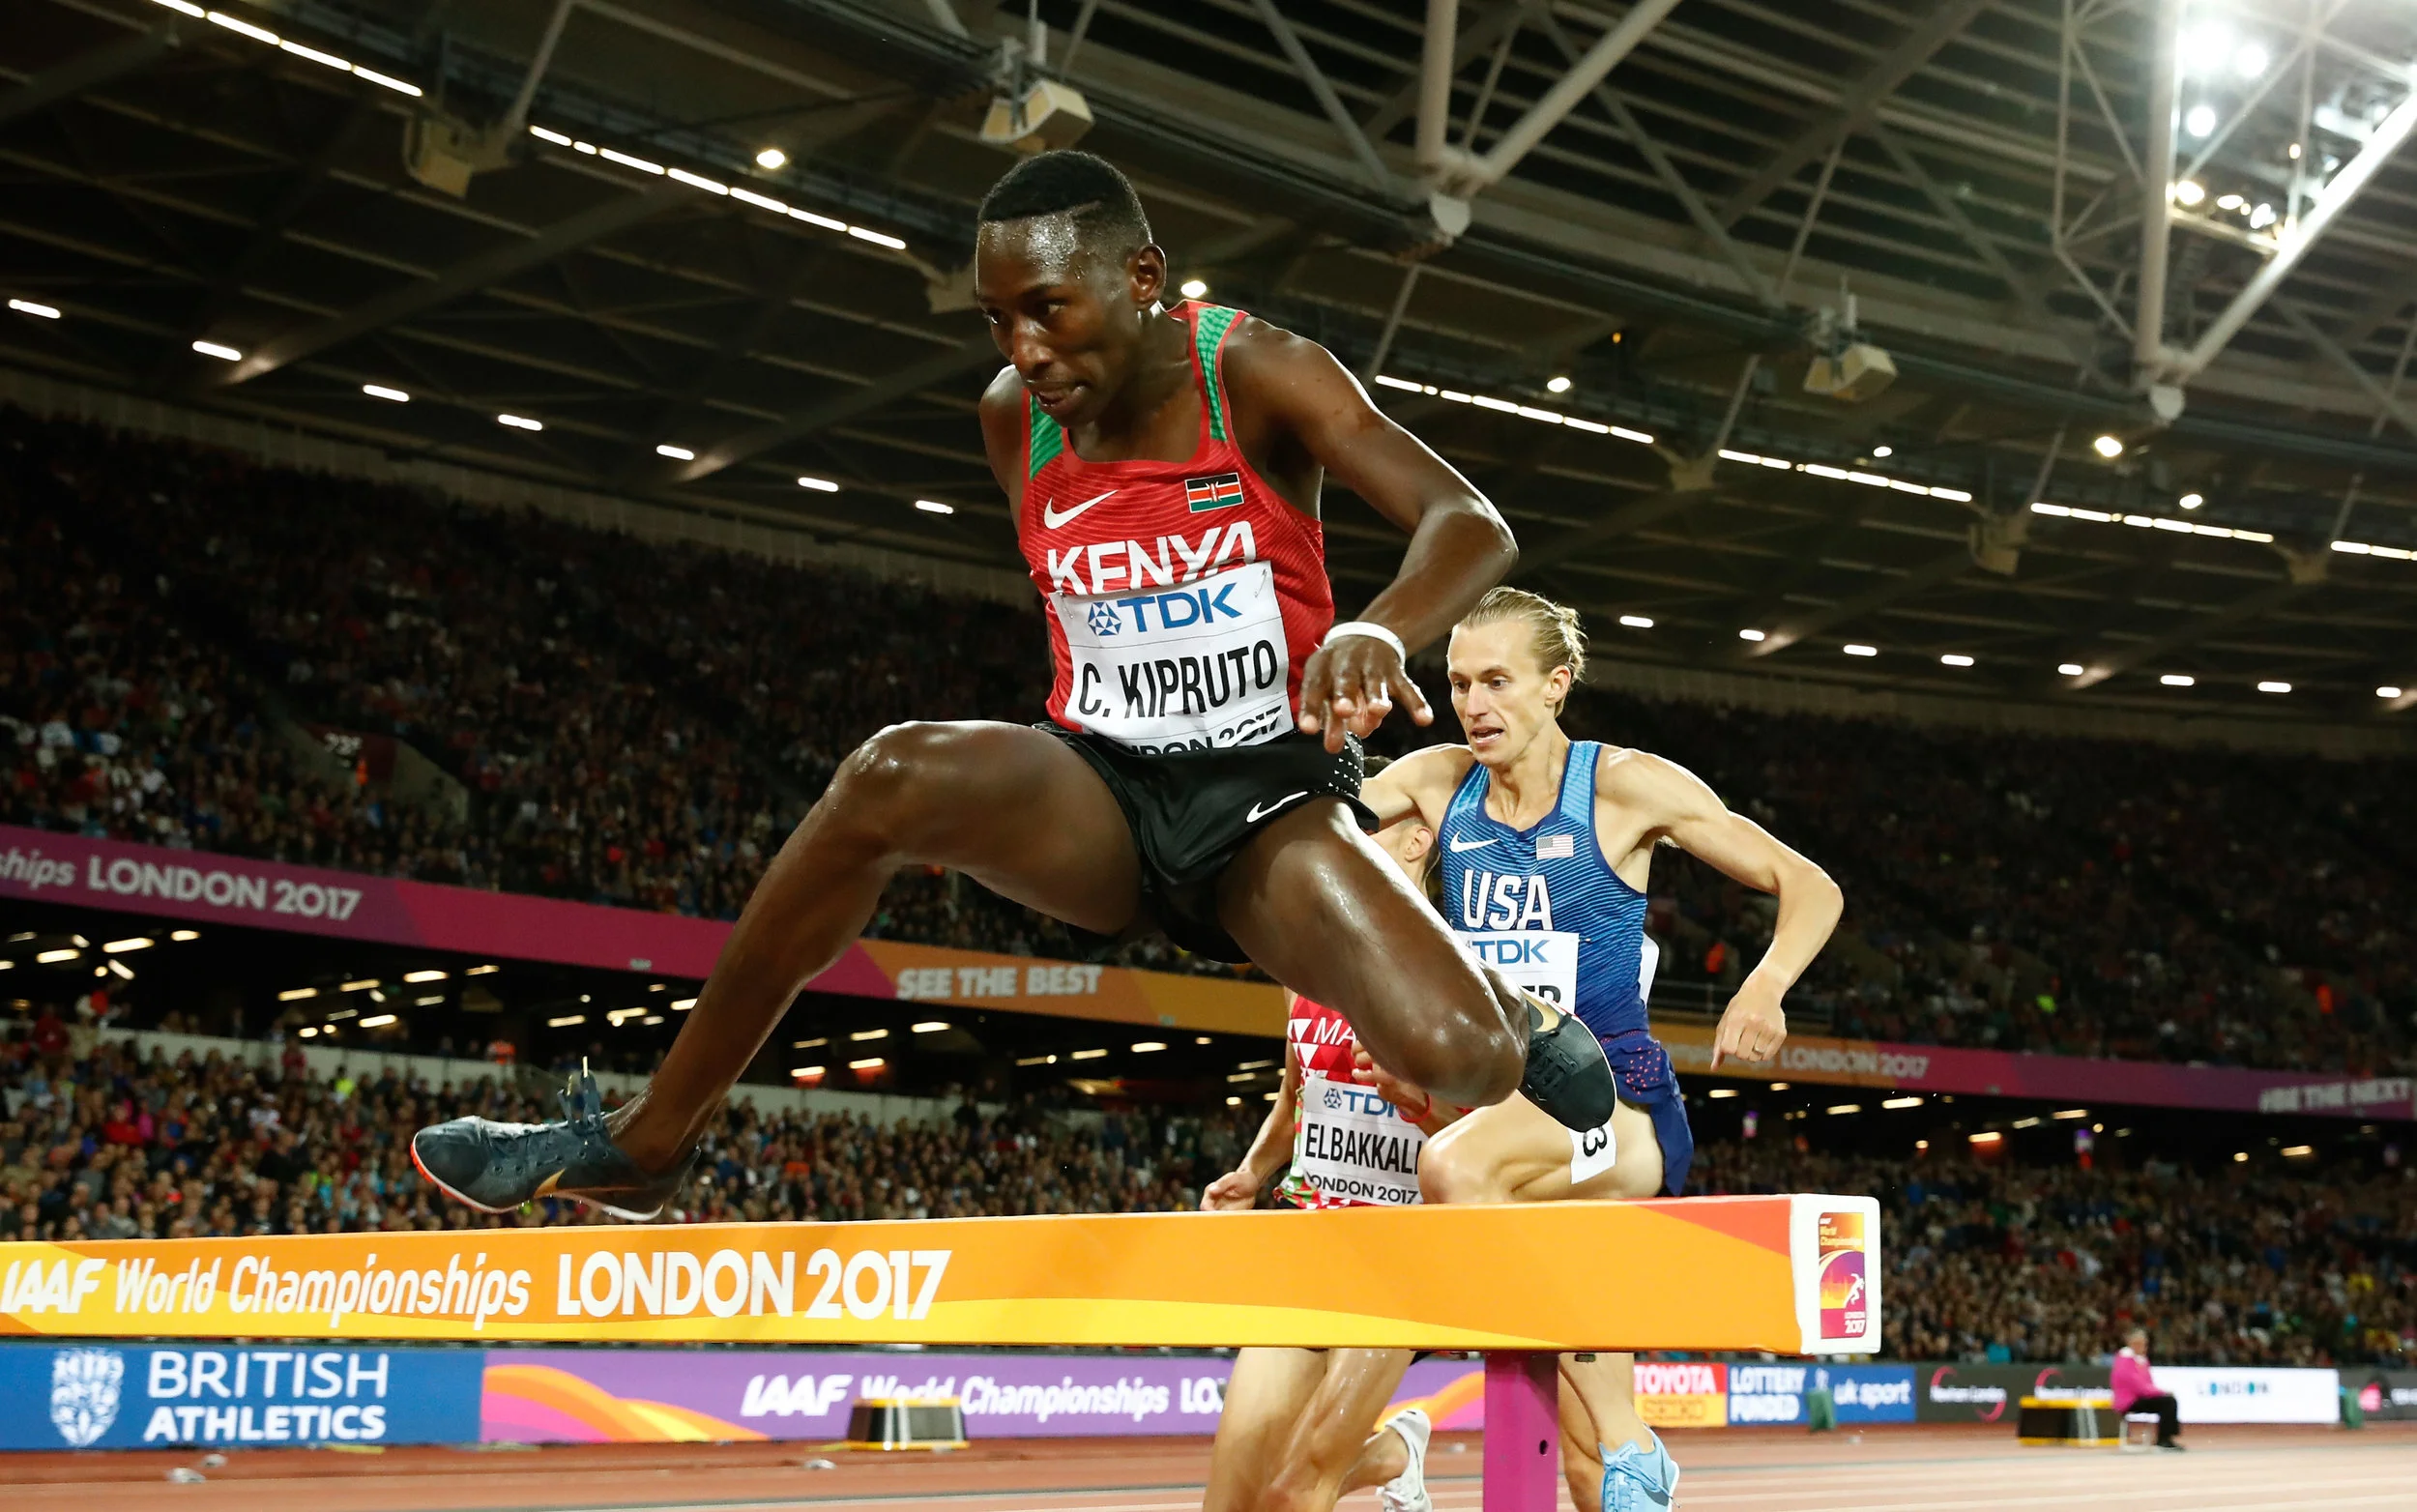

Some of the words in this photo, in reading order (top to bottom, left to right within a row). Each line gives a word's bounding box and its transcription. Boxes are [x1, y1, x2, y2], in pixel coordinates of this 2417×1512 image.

[1048, 521, 1257, 596] KENYA
[1117, 583, 1242, 633] TDK
[1078, 662, 1111, 718] C.
[1118, 639, 1278, 719] KIPRUTO
[88, 857, 268, 912] LONDON
[273, 879, 362, 920] 2017
[1463, 869, 1554, 930] USA
[1471, 939, 1551, 965] TDK
[896, 968, 952, 1000] SEE
[958, 966, 1017, 998] THE
[1026, 964, 1102, 996] BEST
[1781, 1045, 1878, 1075] LONDON
[1880, 1054, 1931, 1079] 2017
[2303, 1083, 2345, 1108] THE
[2349, 1077, 2411, 1105] NEXT
[1378, 1185, 1418, 1205] 2017
[0, 1259, 105, 1314] IAAF
[115, 1258, 221, 1314] World
[228, 1254, 531, 1330] Championships
[557, 1250, 796, 1318] LONDON
[804, 1248, 952, 1321] 2017
[1845, 1319, 1866, 1334] 2017
[147, 1352, 389, 1399] BRITISH
[1634, 1364, 1717, 1394] TOYOTA
[1729, 1363, 1806, 1393] LOTTERY
[741, 1374, 854, 1417] IAAF
[960, 1376, 1170, 1423] Championships
[1729, 1394, 1800, 1422] FUNDED
[1833, 1378, 1859, 1405] uk
[1859, 1380, 1911, 1410] sport
[142, 1405, 388, 1441] ATHLETICS
